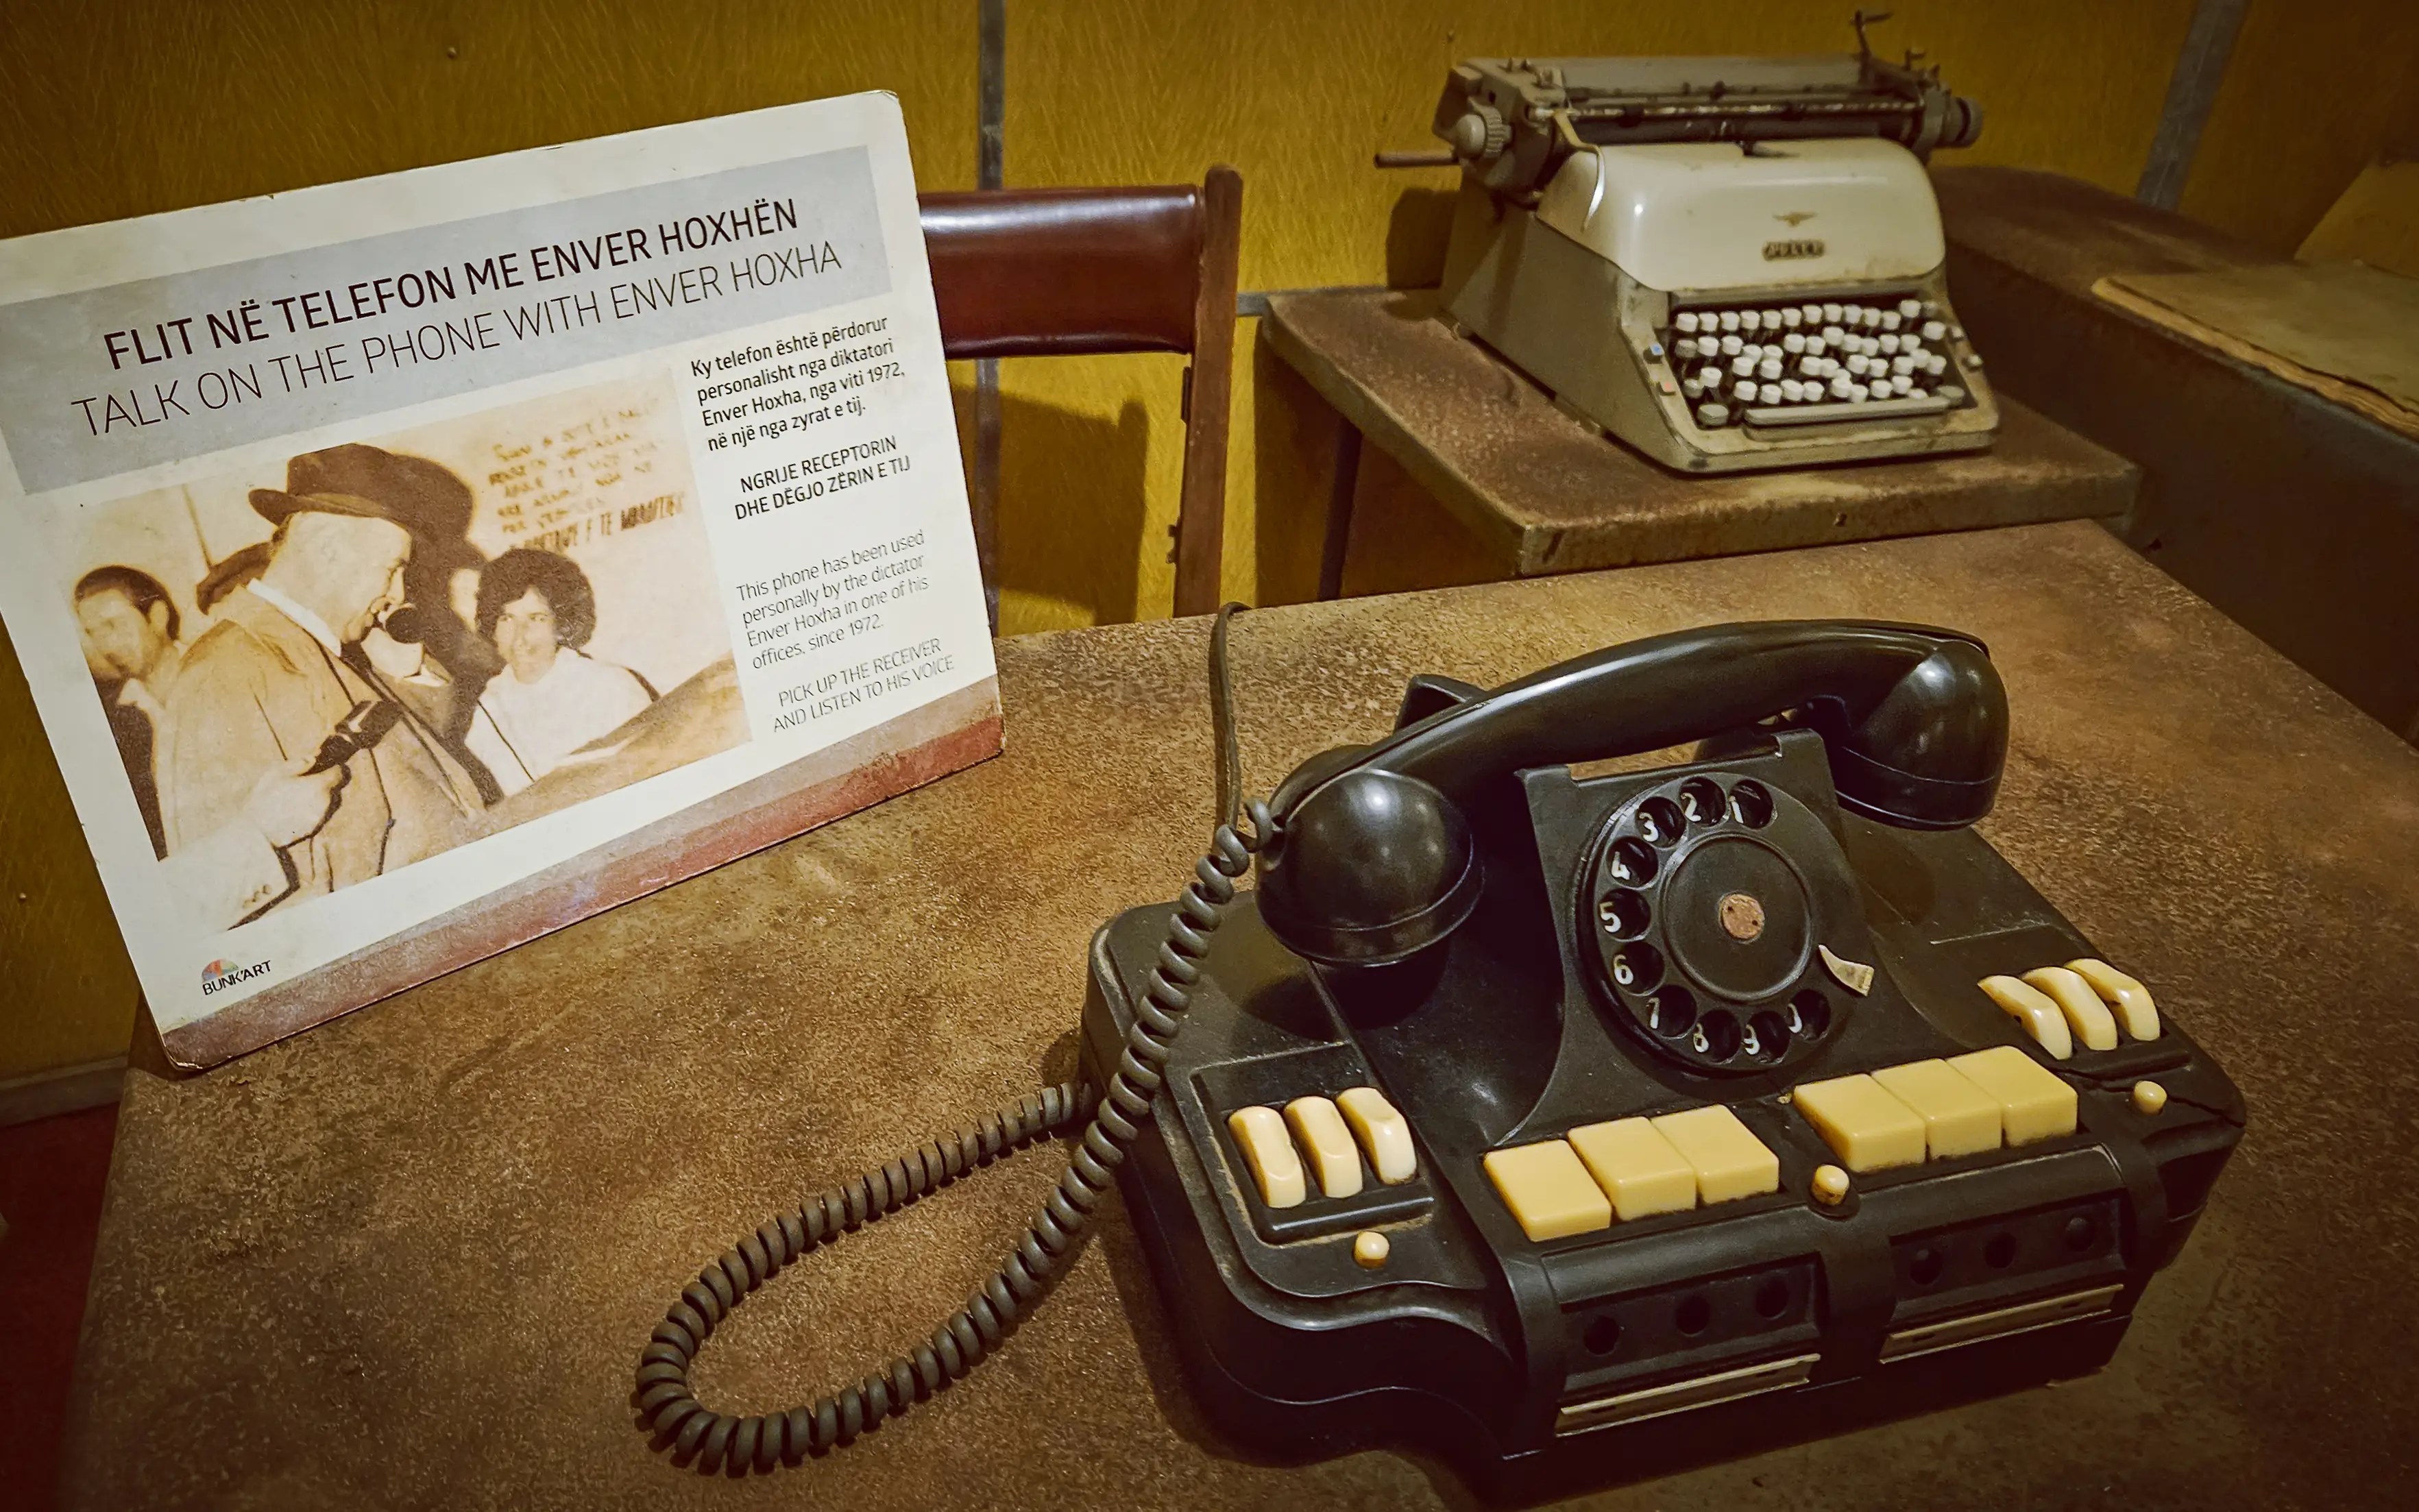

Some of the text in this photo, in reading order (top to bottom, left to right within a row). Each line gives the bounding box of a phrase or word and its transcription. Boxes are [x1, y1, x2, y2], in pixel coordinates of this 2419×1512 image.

[104, 199, 797, 370] FLIT NË TELEFON ME ENVER HOXHËN
[71, 241, 842, 436] TALK ON THE PHONE WITH ENVER HOXHA
[691, 317, 888, 379] Ky telefon është përdorur
[697, 338, 894, 406] personalisht nga diktatori
[702, 403, 749, 426] Enver
[752, 391, 806, 413] Hoxha,
[810, 381, 837, 400] nga
[840, 371, 864, 392] viti
[708, 396, 866, 451] në një nga zyrat e tij.
[735, 455, 910, 520] DHE DËGJO ZËRIN E TIJ
[740, 435, 897, 493] NGRIJE RECEPTORIN
[736, 529, 925, 601] This phone has been used
[743, 554, 925, 628] personally by the dictator
[747, 576, 929, 647] Enver Hoxha in one of his
[808, 626, 844, 651] since
[774, 655, 955, 733] AND LISTEN TO HIS VOICE
[778, 637, 942, 707] PICK UP THE RECEIVER
[1639, 812, 1659, 842] 3
[1681, 792, 1702, 822] 2
[1611, 851, 1631, 881] 4
[1599, 901, 1621, 933] 5
[1613, 954, 1633, 984] 6
